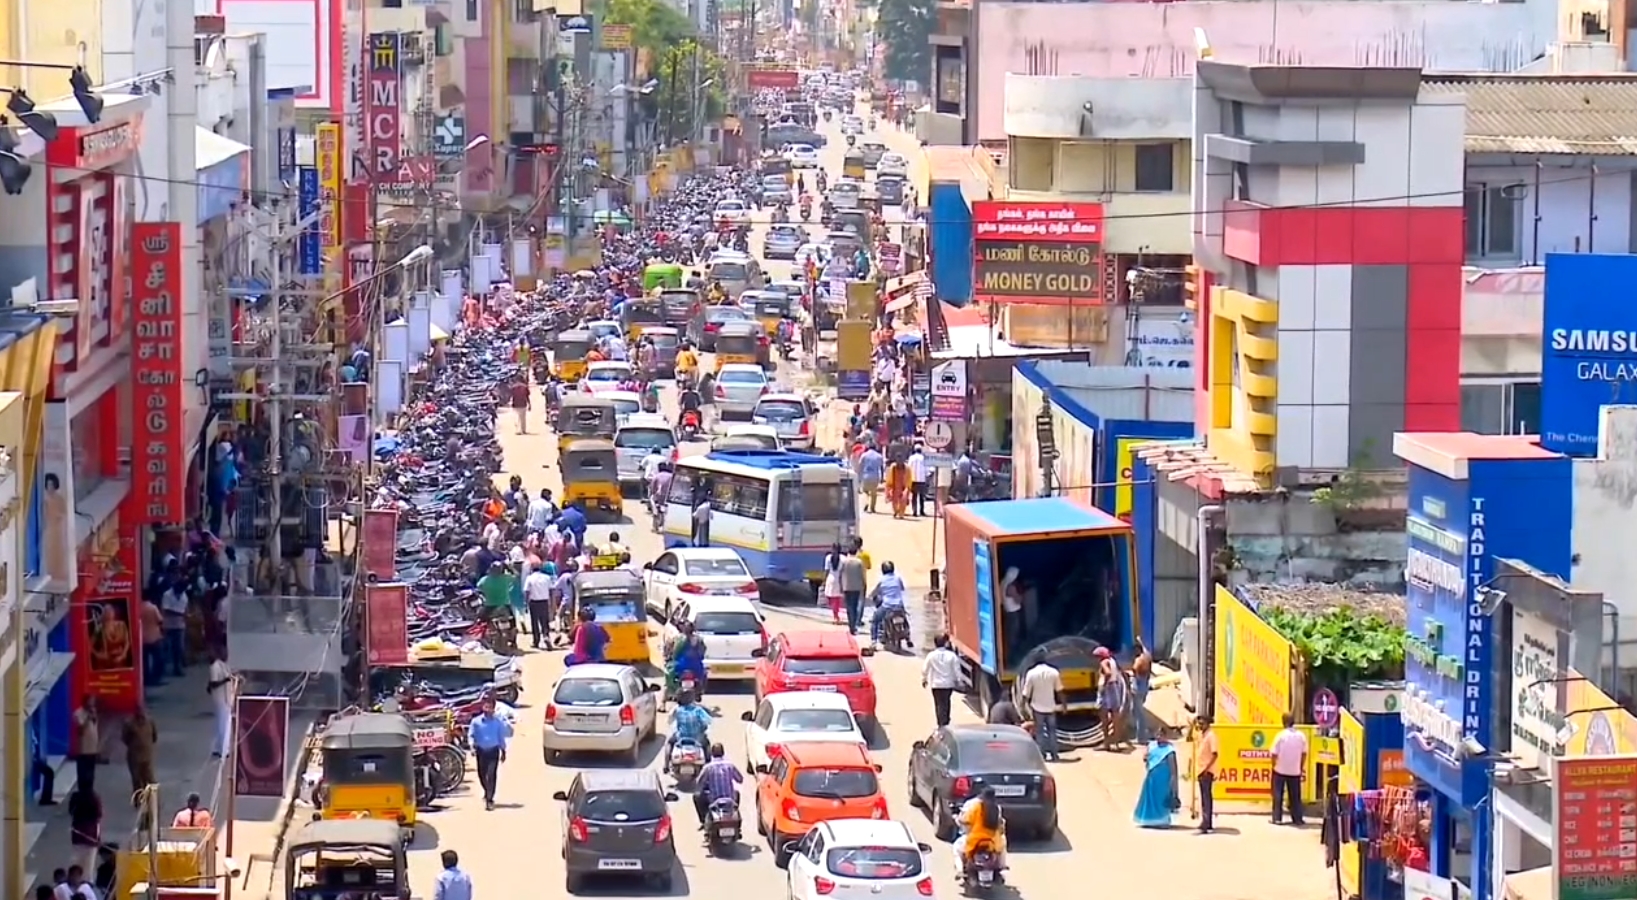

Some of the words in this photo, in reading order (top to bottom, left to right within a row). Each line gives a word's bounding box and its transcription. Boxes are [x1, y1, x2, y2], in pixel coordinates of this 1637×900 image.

[986, 244, 1024, 262] மணி
[1029, 244, 1090, 265] கோல்டு
[984, 272, 1043, 291] MONEY
[1046, 273, 1092, 292] GOLD
[1546, 431, 1566, 442] The
